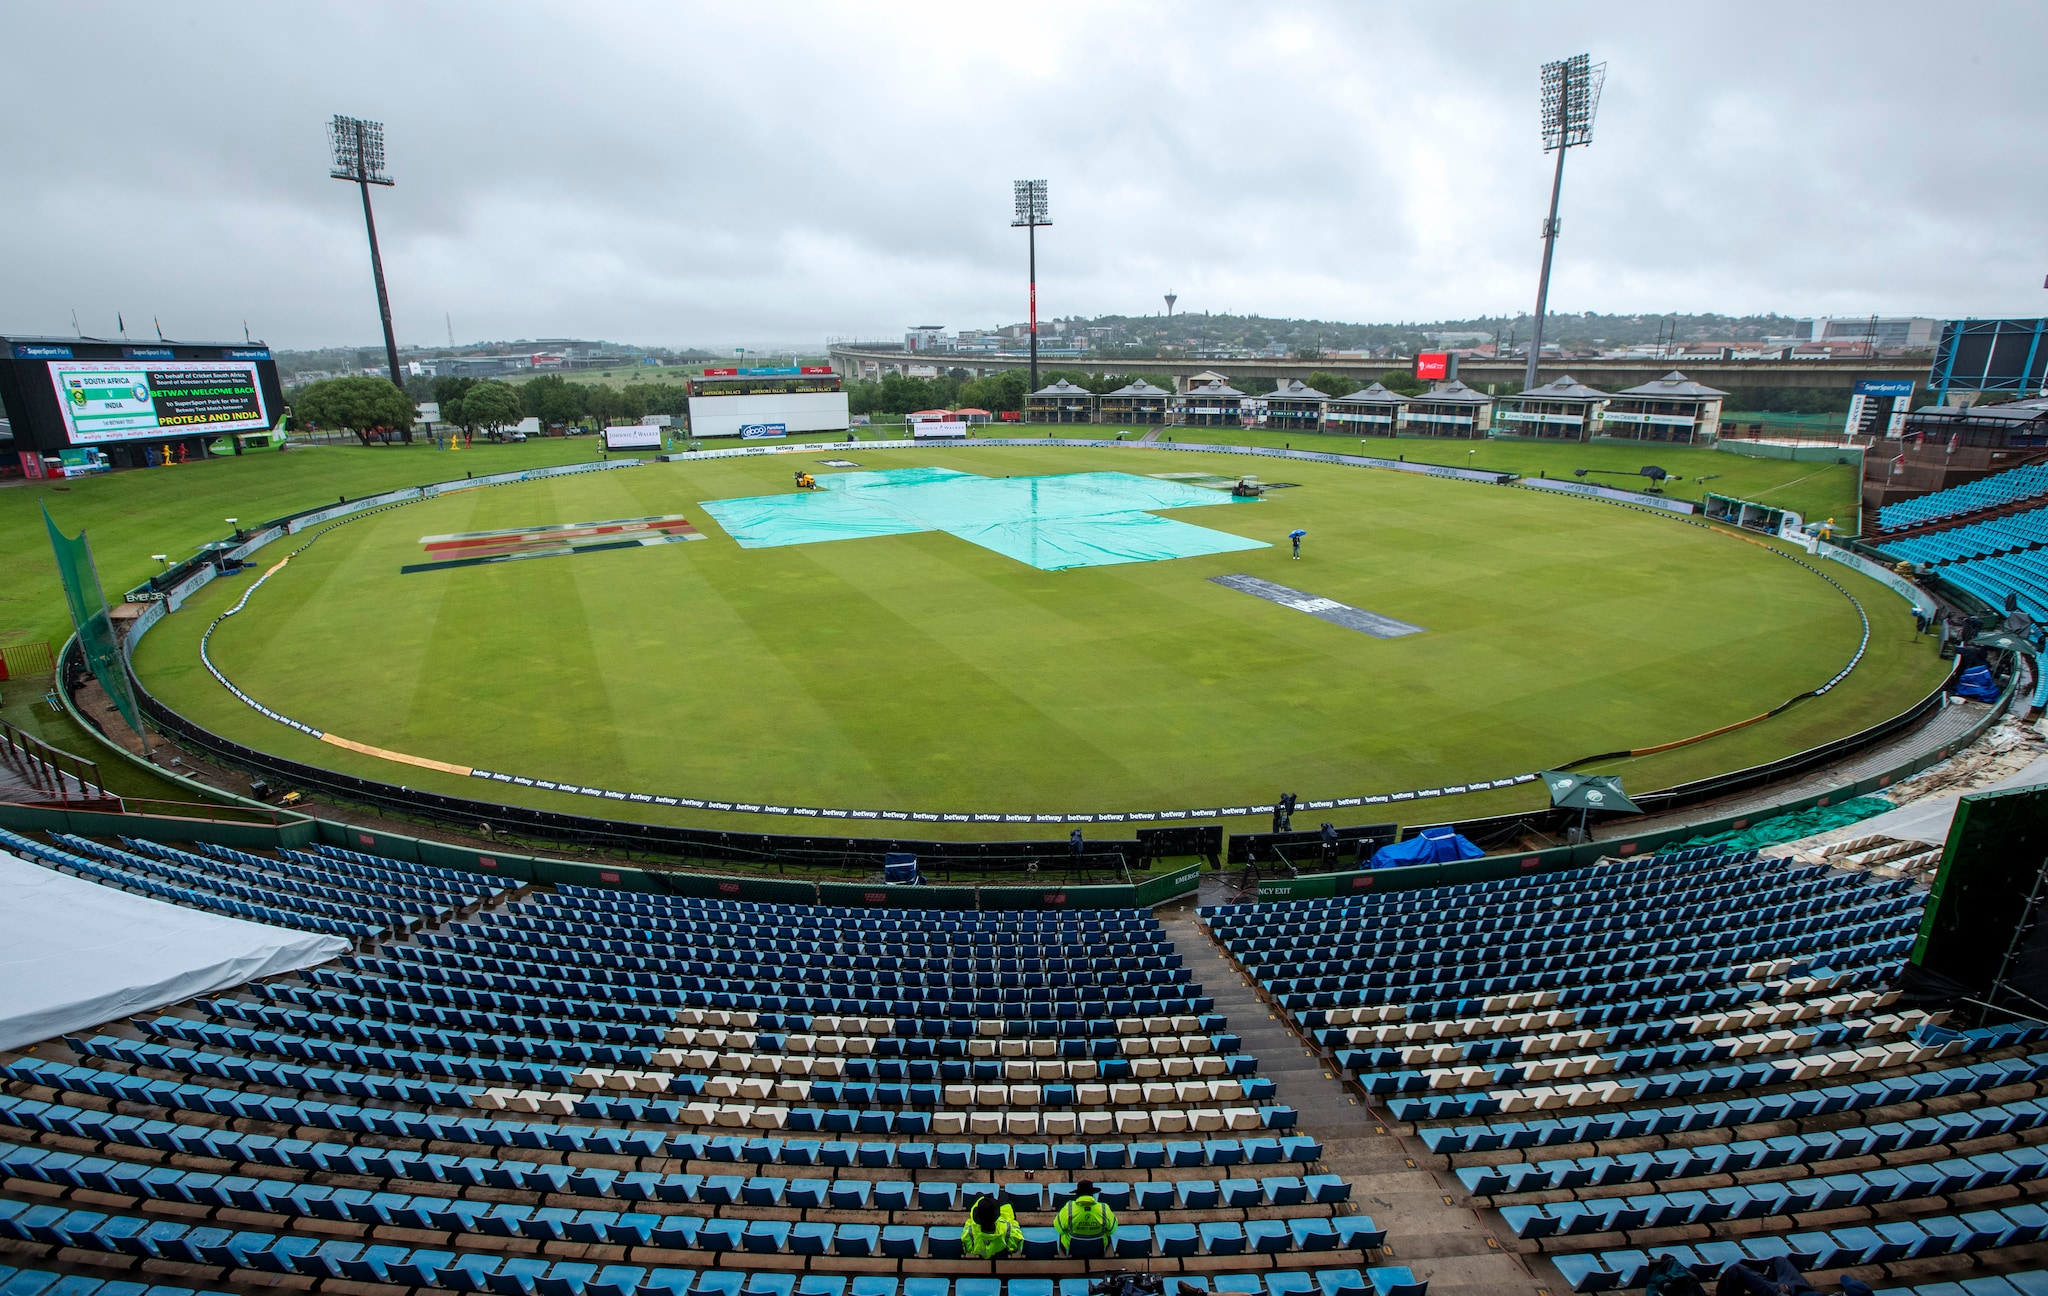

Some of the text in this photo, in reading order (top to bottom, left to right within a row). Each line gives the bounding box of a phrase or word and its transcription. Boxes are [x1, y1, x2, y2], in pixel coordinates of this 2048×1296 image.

[107, 390, 113, 398] V
[151, 389, 188, 397] BETWAY
[158, 415, 206, 425] PROTEAS
[233, 412, 258, 420] INDIA
[472, 768, 492, 779] betway
[492, 772, 512, 783] betway
[1514, 774, 1536, 782] betway
[514, 776, 534, 787] betway
[536, 780, 556, 790] betway
[1492, 778, 1514, 787] betway
[558, 784, 578, 794] betway
[580, 786, 602, 797] betway
[604, 790, 626, 800] betway
[630, 792, 652, 803] betway
[654, 796, 678, 806] betway
[682, 798, 704, 808] betway
[1308, 800, 1334, 809] betway
[708, 802, 732, 811] betway
[736, 804, 760, 813] betway
[764, 804, 790, 815] betway
[794, 808, 818, 817] betway
[822, 808, 848, 818] betway
[852, 810, 878, 819] betway
[882, 810, 908, 821] betway
[1130, 812, 1156, 821] betway
[1160, 810, 1186, 819] betway
[1192, 810, 1216, 818] betway
[1222, 808, 1248, 816] betway
[912, 812, 938, 822] betway
[944, 814, 970, 823] betway
[974, 814, 1000, 822] betway
[1006, 814, 1032, 823] betway
[1036, 814, 1062, 823] betway
[1068, 814, 1094, 823] betway
[1098, 814, 1124, 822] betway
[1175, 871, 1200, 884] EMERGE
